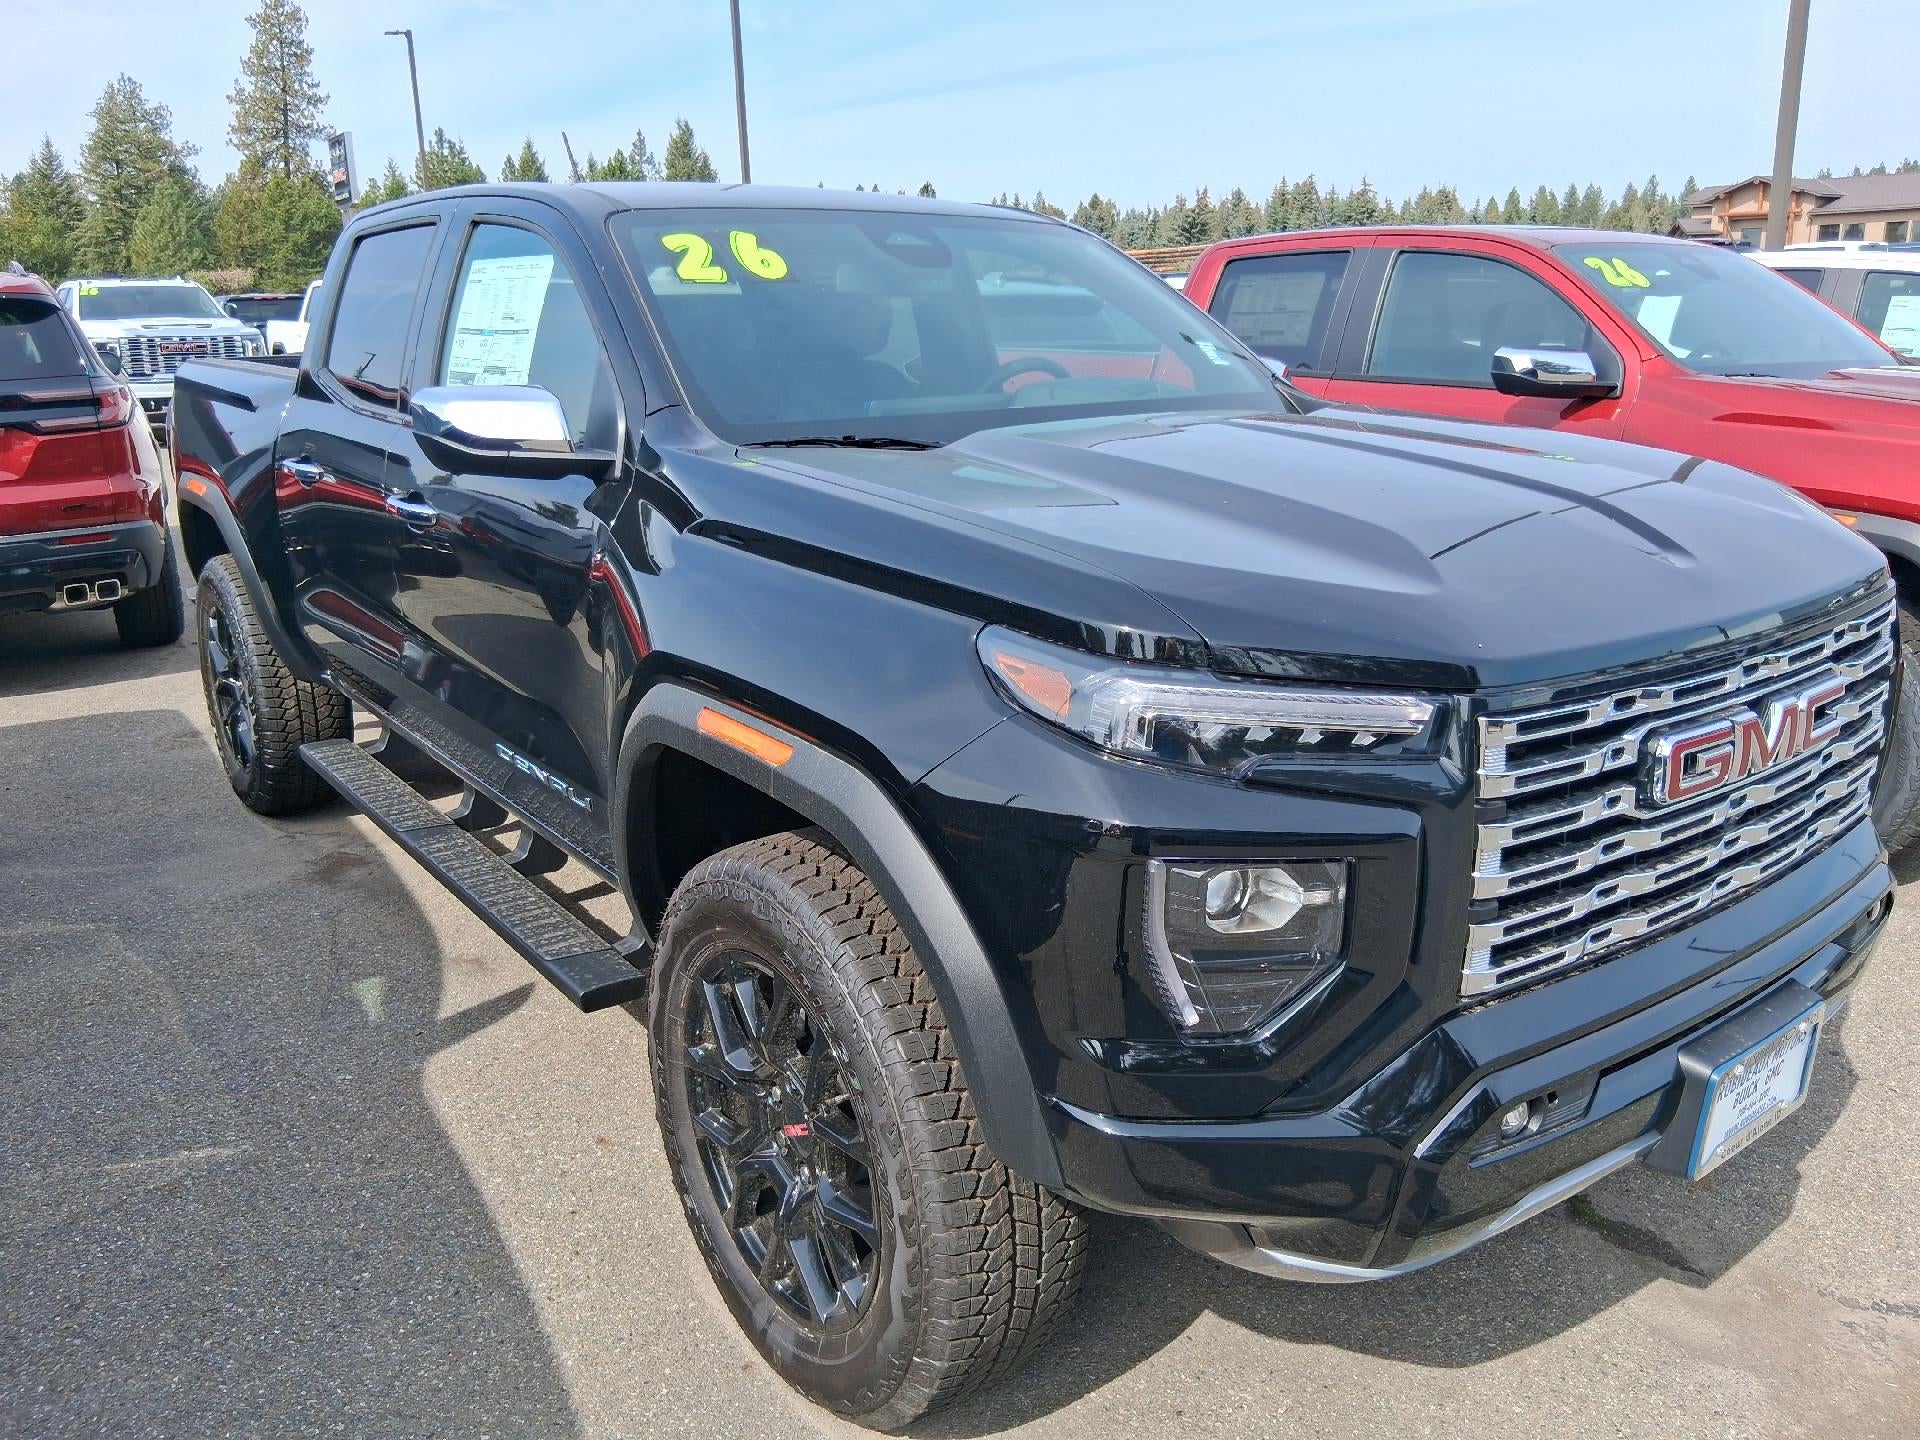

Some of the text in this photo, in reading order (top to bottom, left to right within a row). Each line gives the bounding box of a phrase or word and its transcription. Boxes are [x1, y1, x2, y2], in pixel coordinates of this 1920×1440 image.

[661, 230, 788, 284] 26
[1583, 257, 1650, 288] 26
[160, 342, 208, 352] GMC
[1655, 677, 1848, 804] GMC
[1732, 1060, 1784, 1109] BUICK GMC
